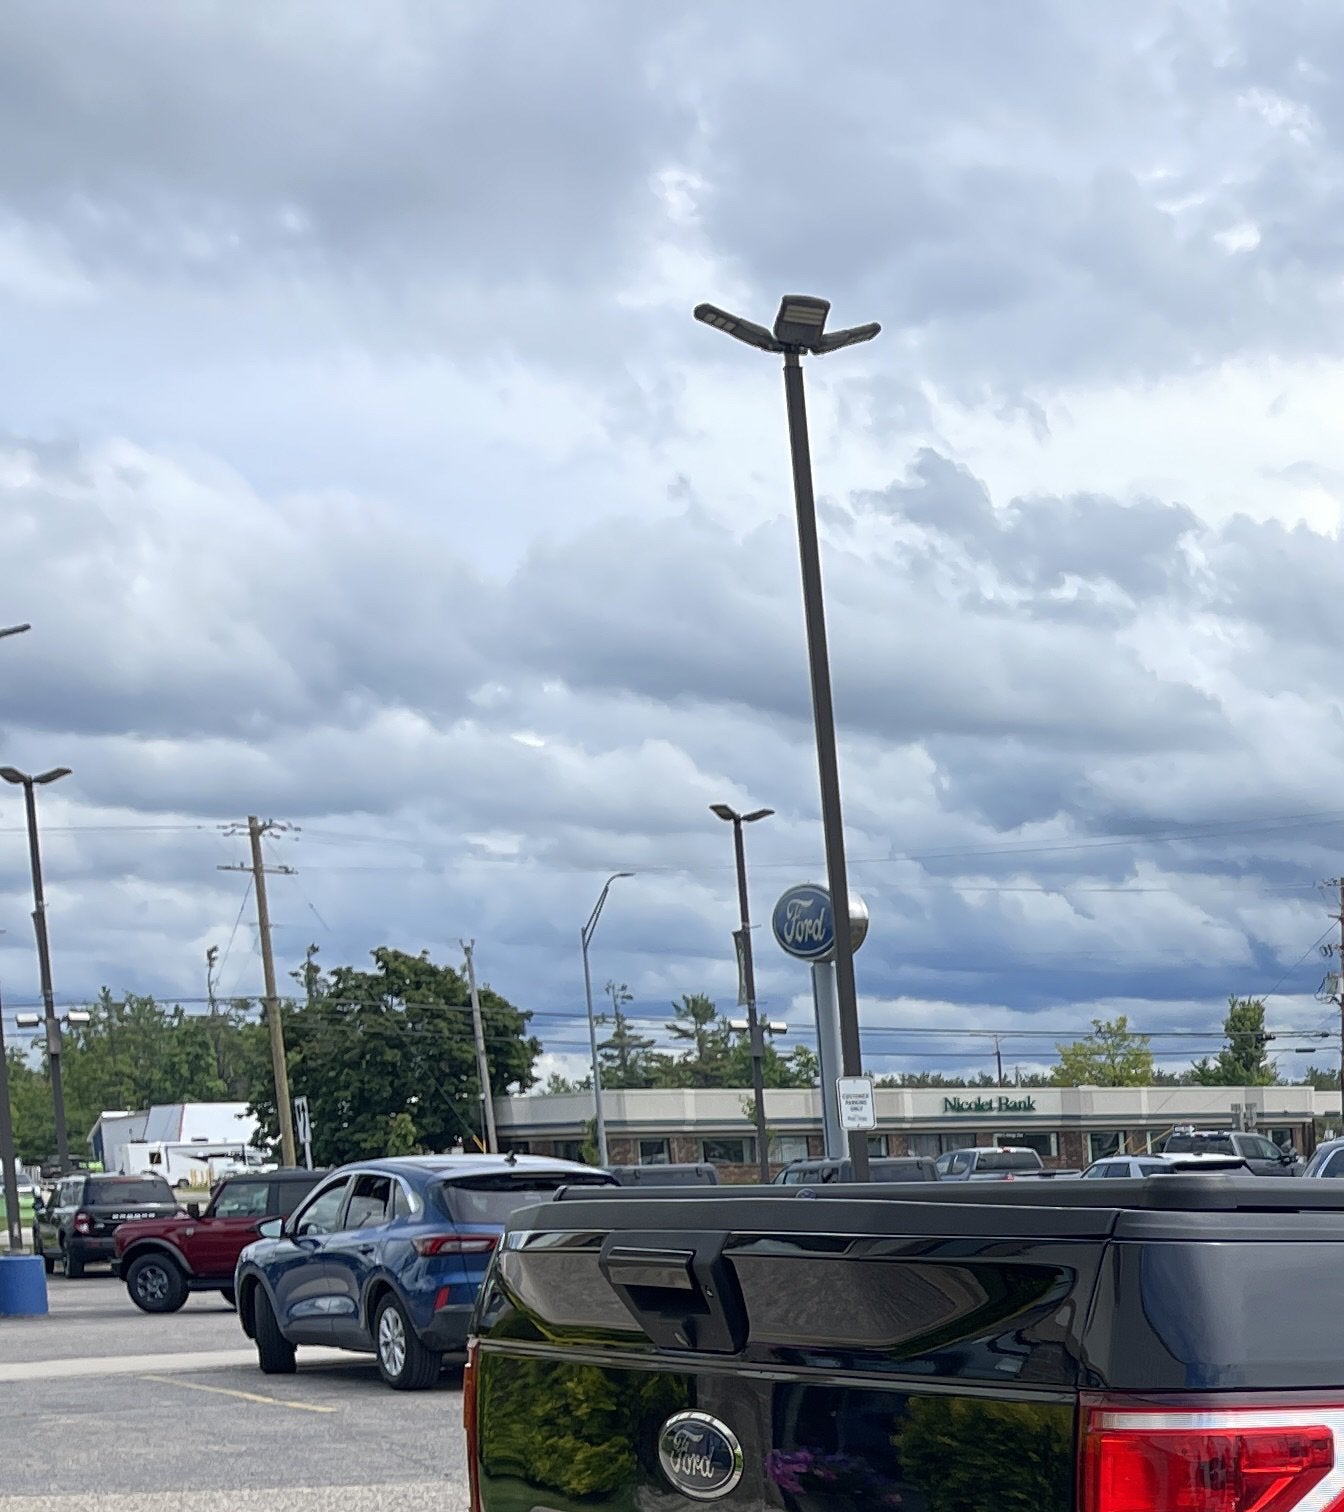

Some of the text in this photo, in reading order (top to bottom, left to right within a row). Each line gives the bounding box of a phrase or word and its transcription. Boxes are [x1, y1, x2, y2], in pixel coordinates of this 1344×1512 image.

[783, 898, 827, 944] Ford
[943, 1095, 1036, 1113] Nicolet Bank
[670, 1429, 715, 1478] Ford
